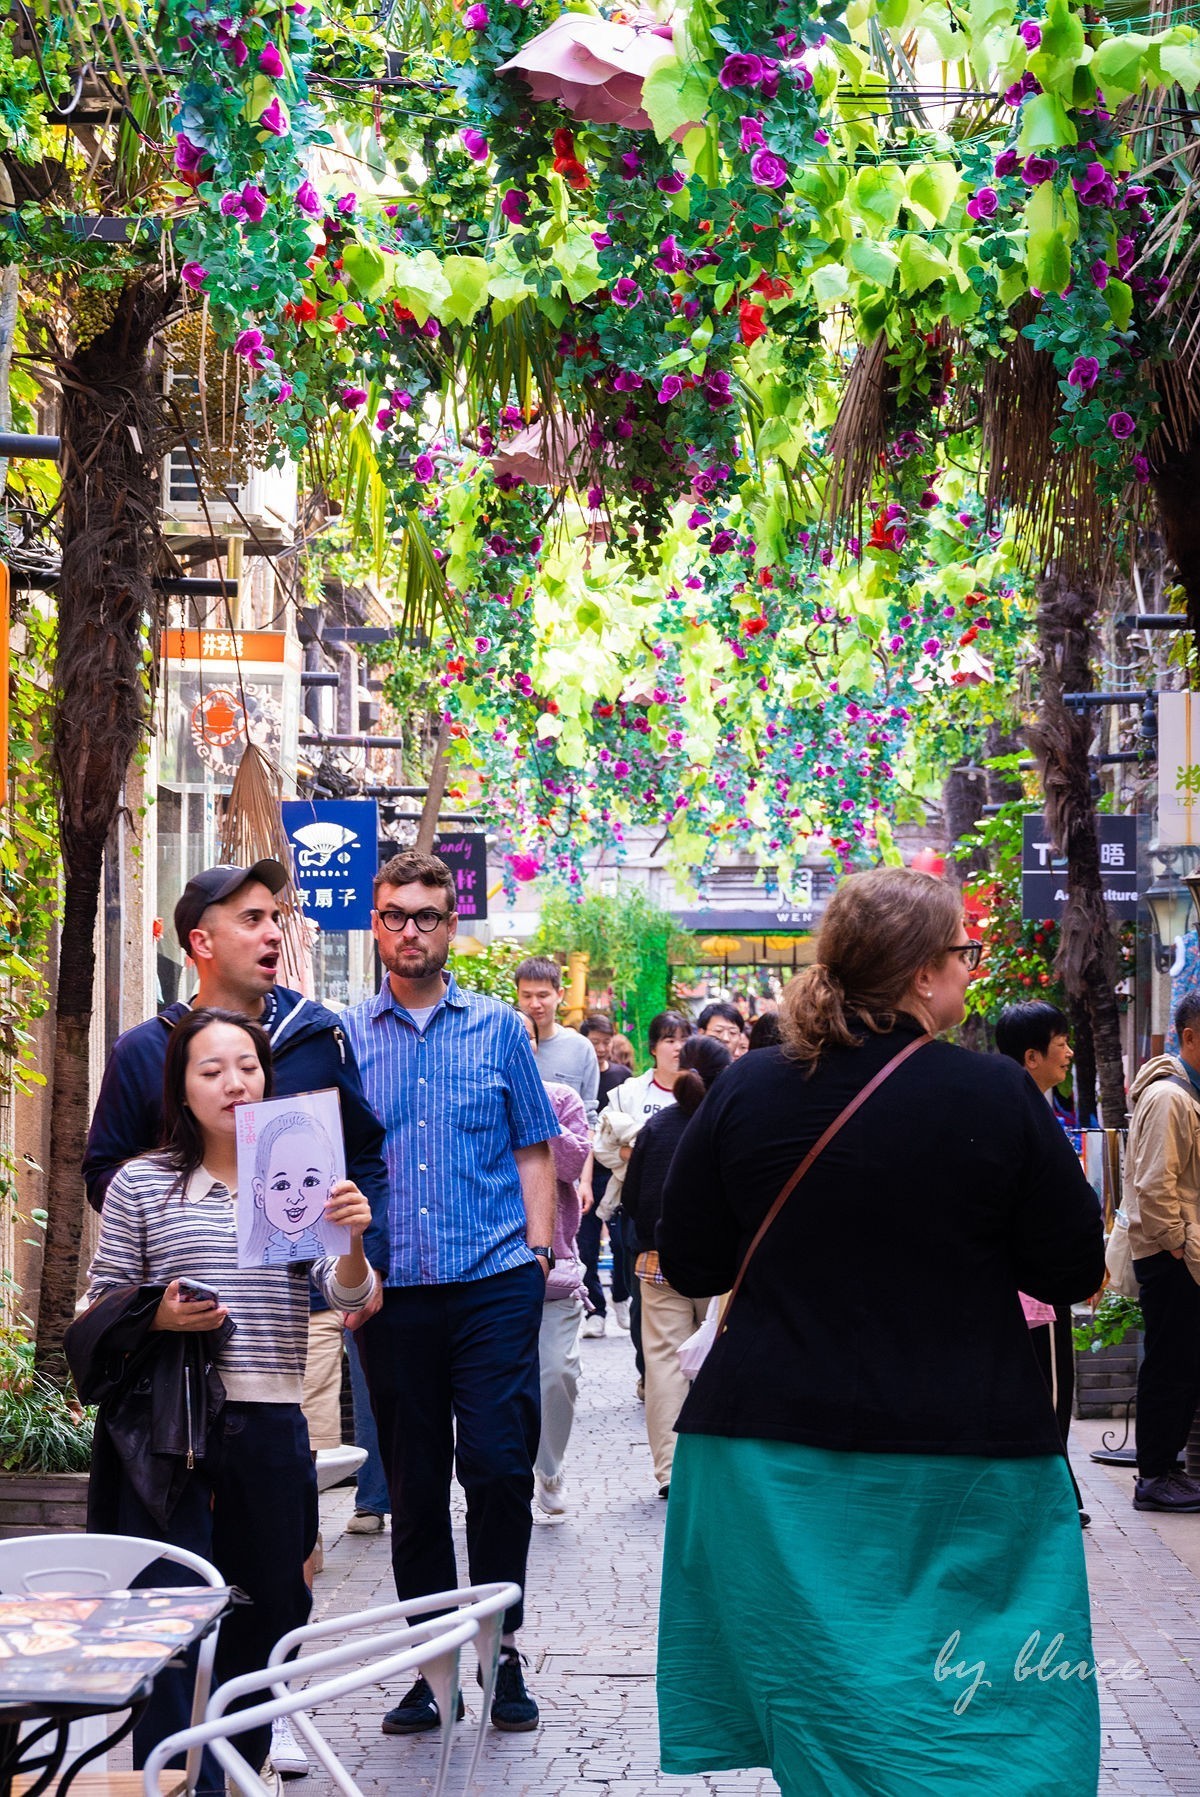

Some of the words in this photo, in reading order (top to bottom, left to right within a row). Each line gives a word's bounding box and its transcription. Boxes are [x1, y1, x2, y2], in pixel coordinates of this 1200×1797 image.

[435, 838, 473, 860] andy
[293, 888, 357, 908] 京扇子
[776, 913, 812, 922] WEN
